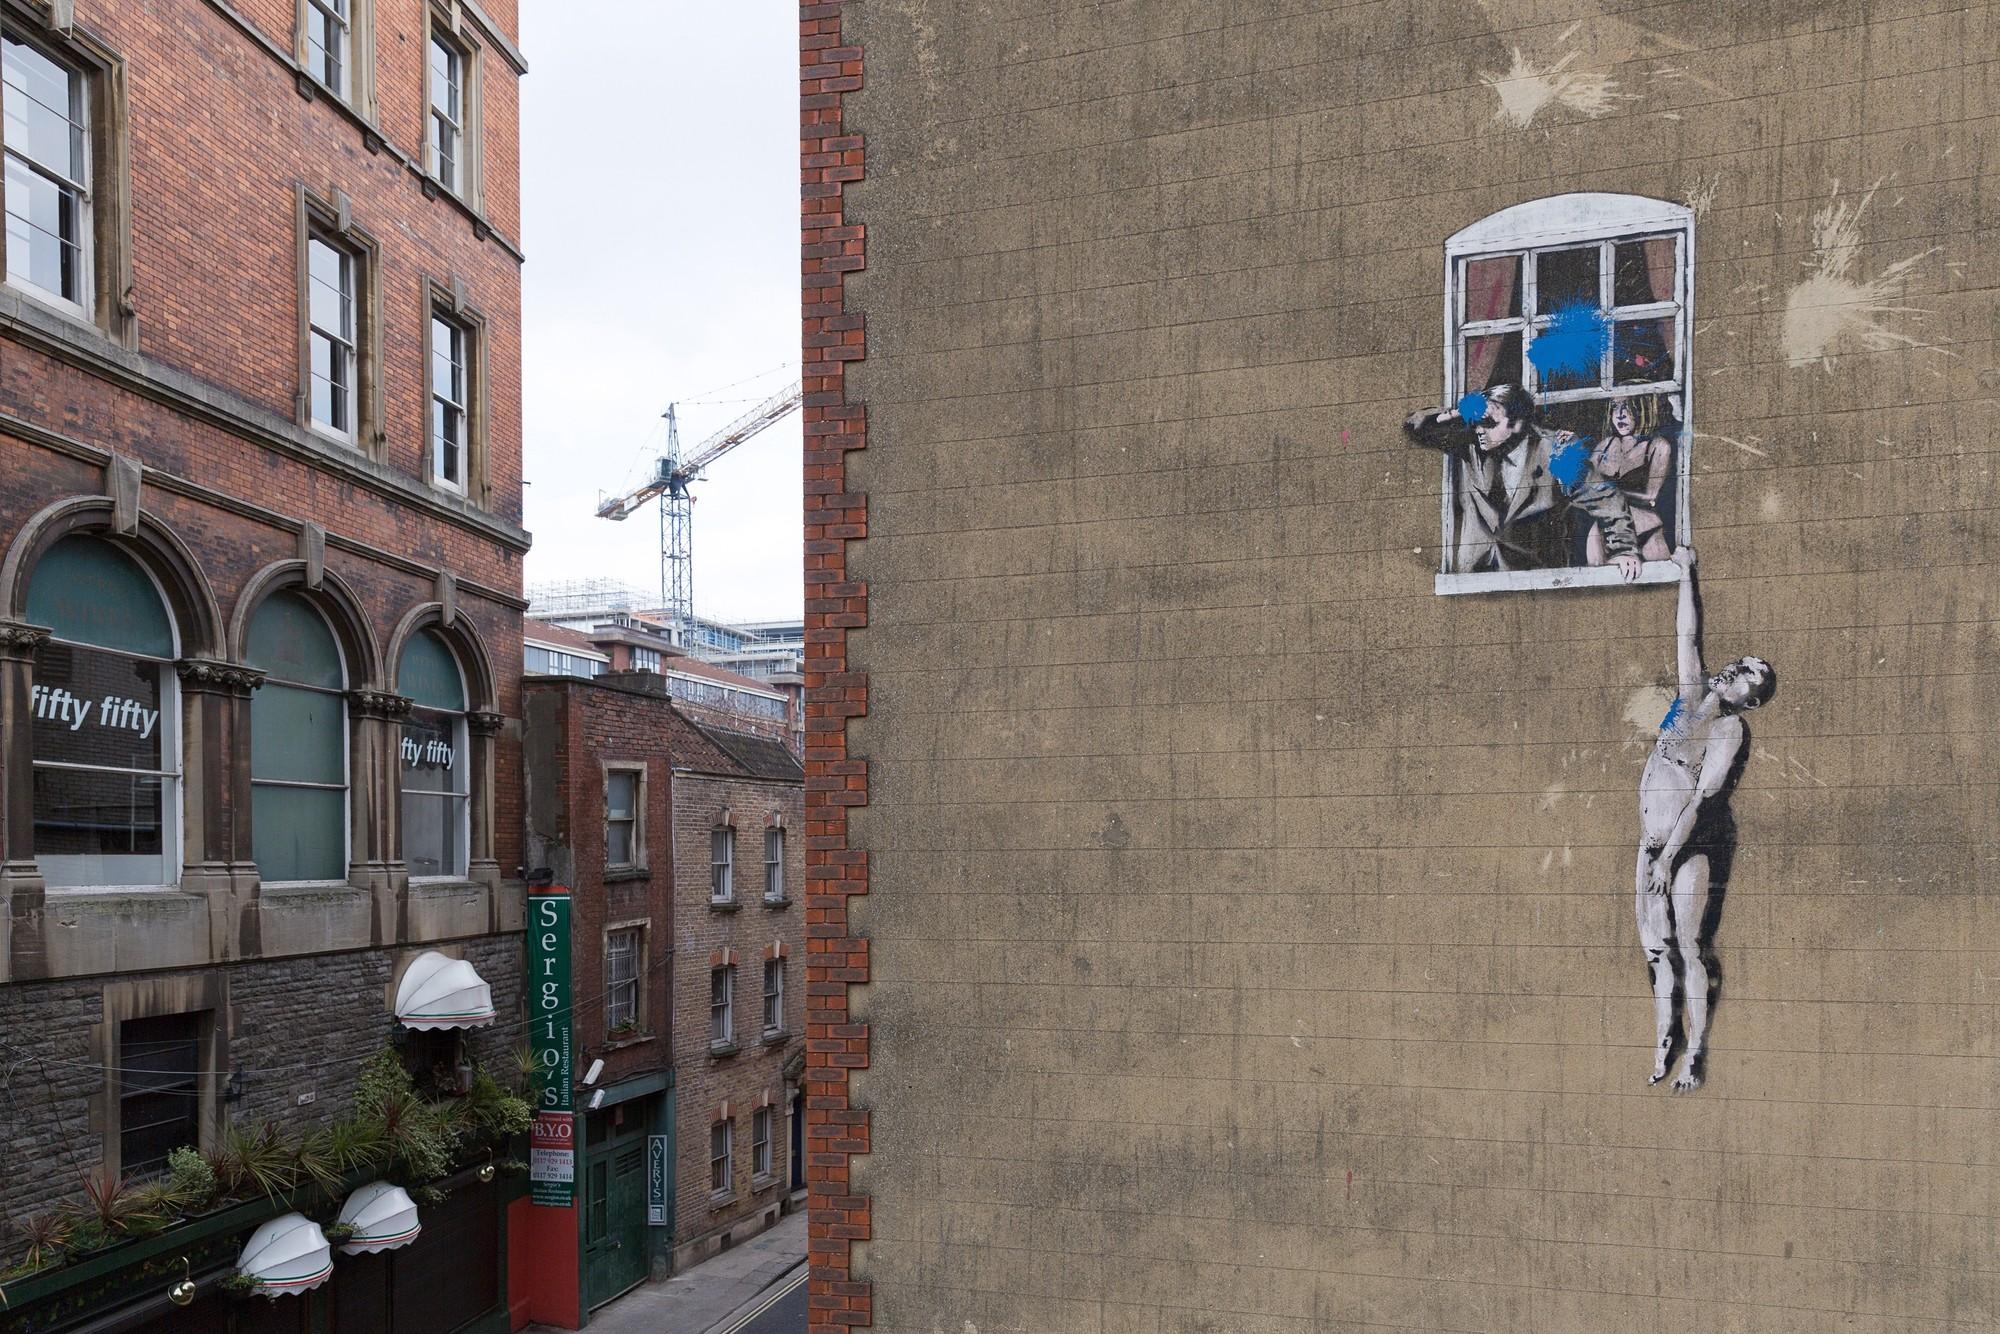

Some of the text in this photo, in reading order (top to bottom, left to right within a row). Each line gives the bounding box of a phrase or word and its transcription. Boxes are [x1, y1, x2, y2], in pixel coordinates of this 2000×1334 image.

[32, 685, 159, 739] fifty fifty
[401, 737, 456, 770] fty fifty
[541, 900, 559, 1106] Sergio's
[561, 1027, 569, 1106] Italian Restaurant
[535, 1122, 572, 1138] B.Y.O
[651, 1138, 663, 1198] AVERYS
